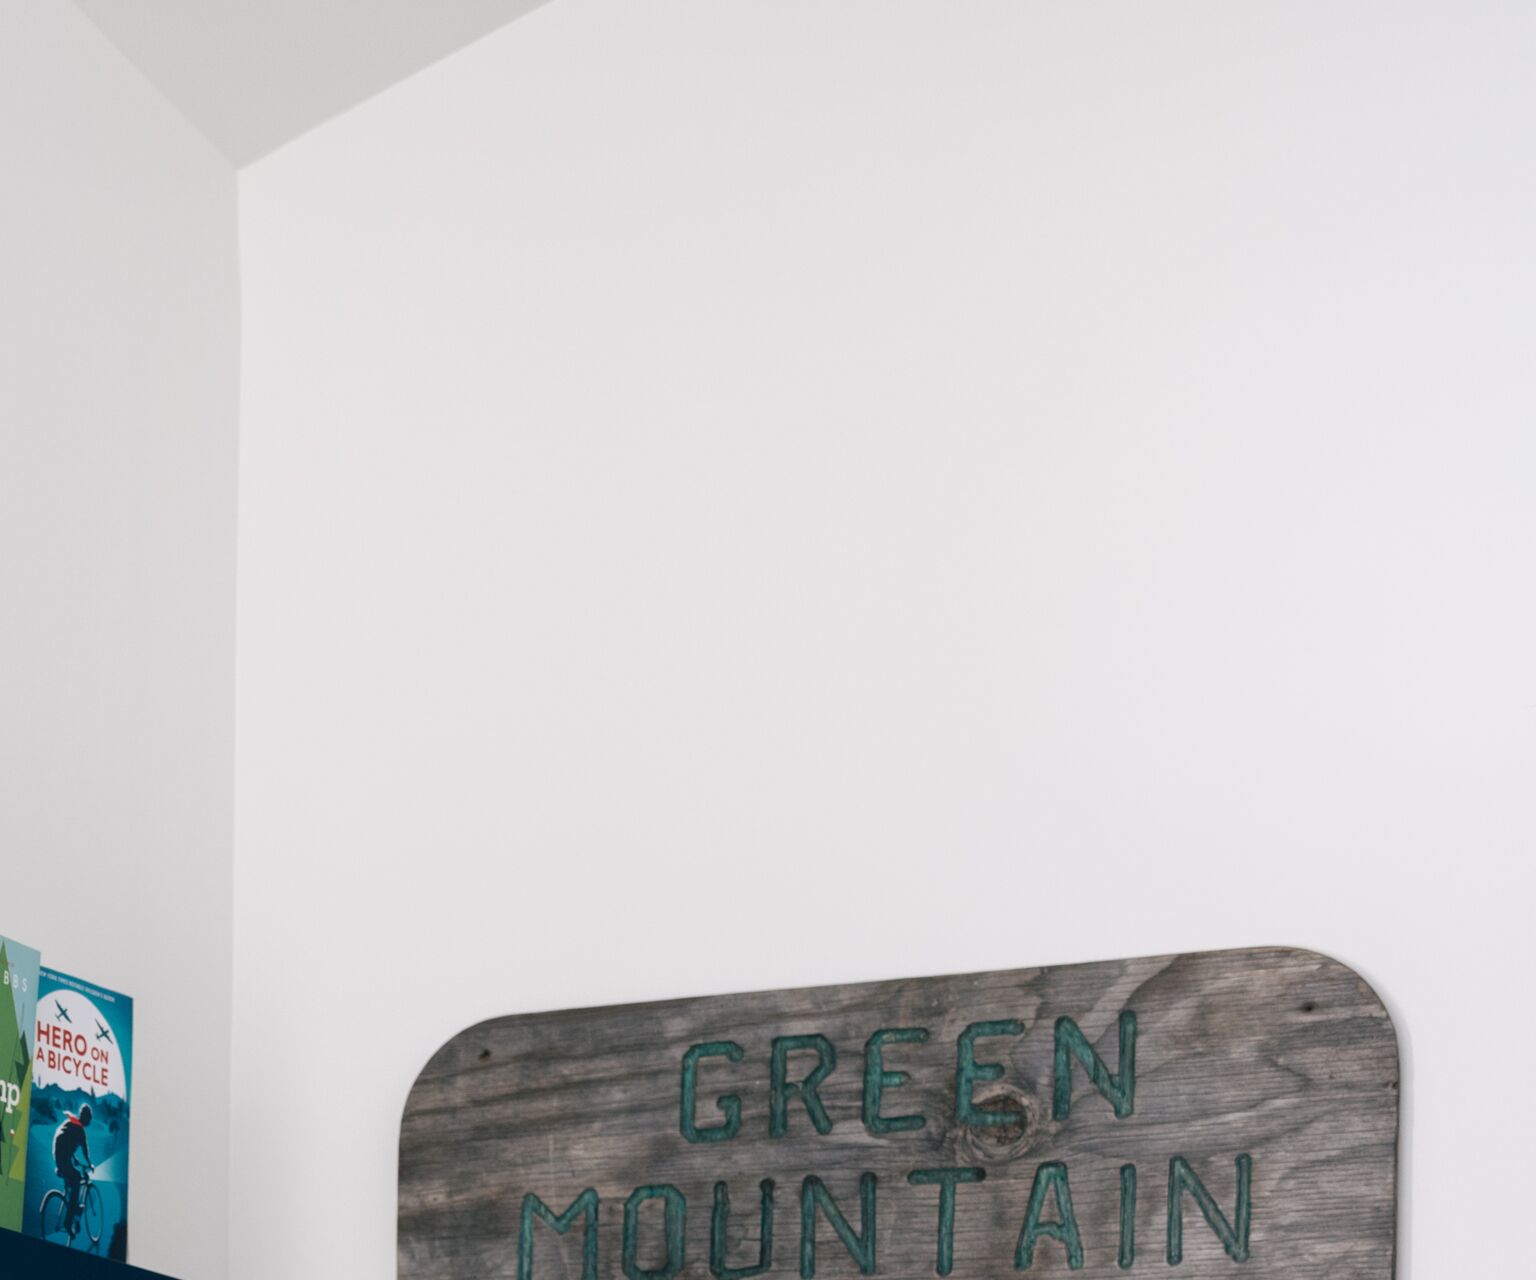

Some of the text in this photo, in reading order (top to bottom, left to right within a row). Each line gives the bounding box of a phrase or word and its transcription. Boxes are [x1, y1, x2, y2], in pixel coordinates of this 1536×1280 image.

[37, 1020, 109, 1065] HERO ON
[36, 1047, 109, 1087] A BICYCLE
[680, 1009, 1138, 1144] GREEN
